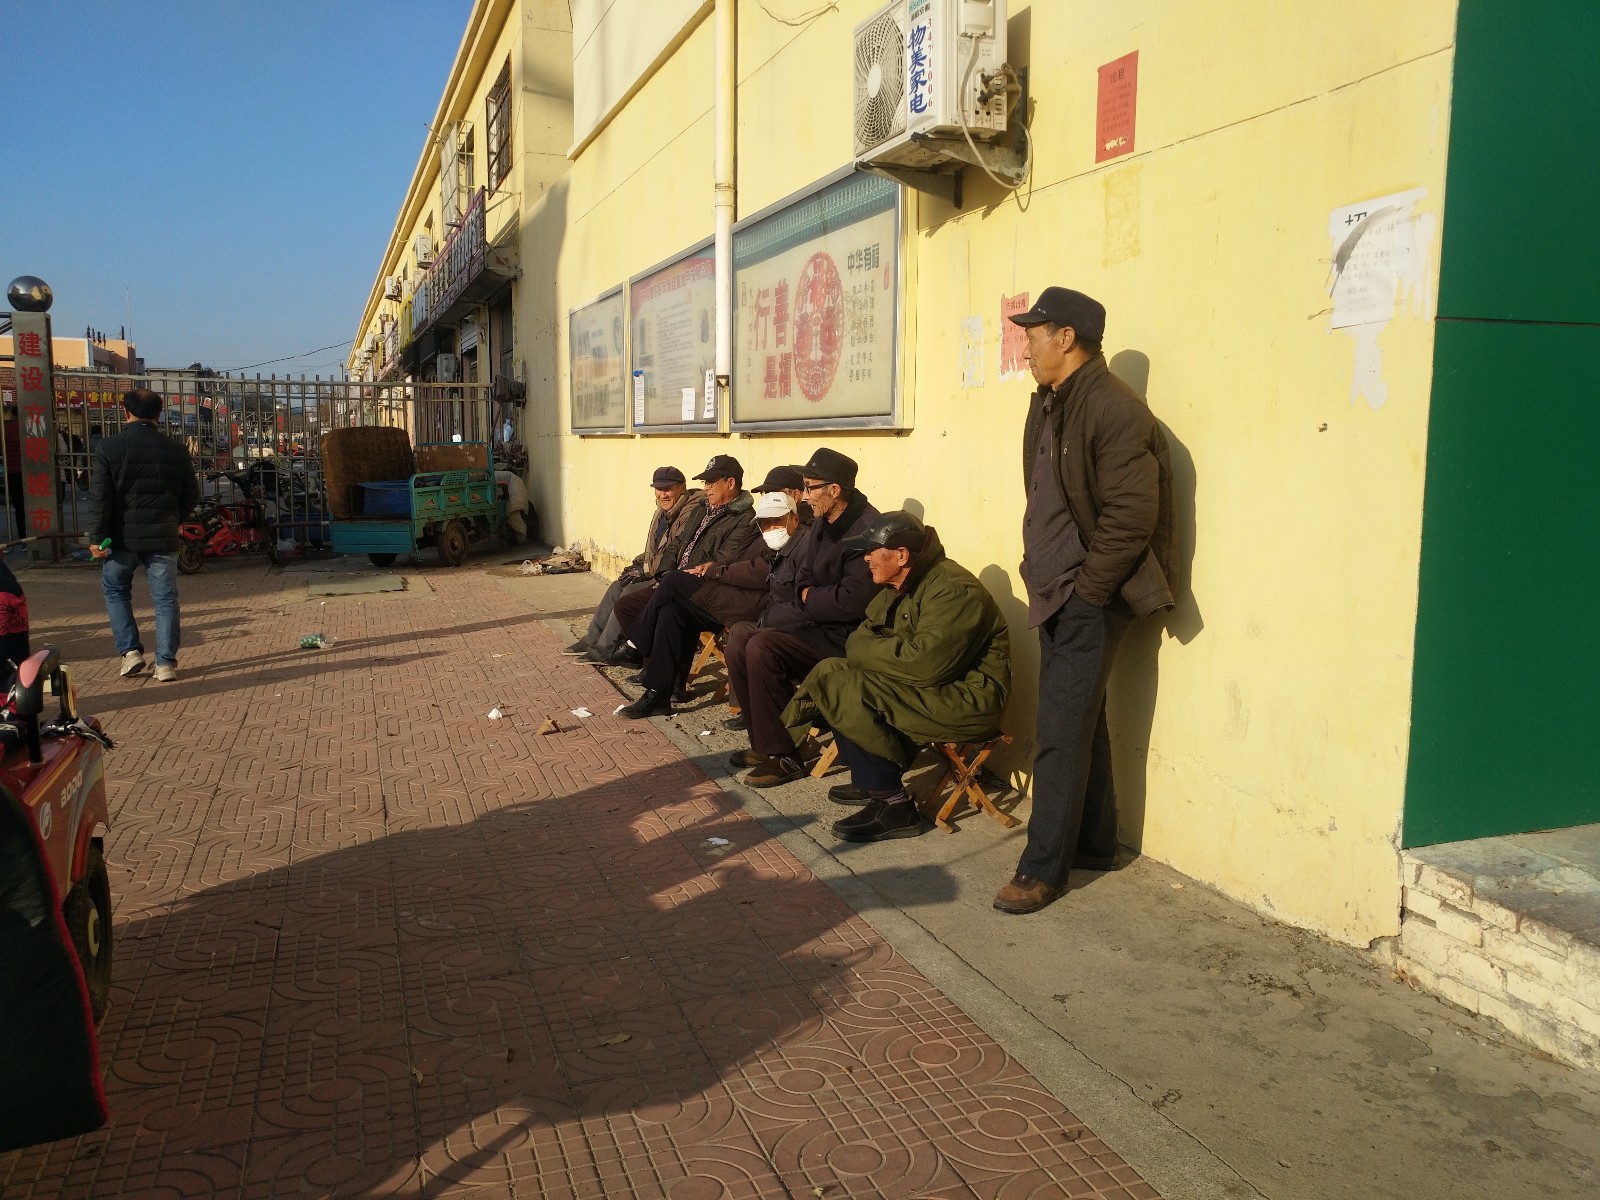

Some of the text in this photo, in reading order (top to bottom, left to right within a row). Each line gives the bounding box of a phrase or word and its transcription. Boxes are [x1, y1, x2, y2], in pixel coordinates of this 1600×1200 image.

[907, 24, 928, 114] 物美家电
[18, 331, 53, 532] 建设文明城市
